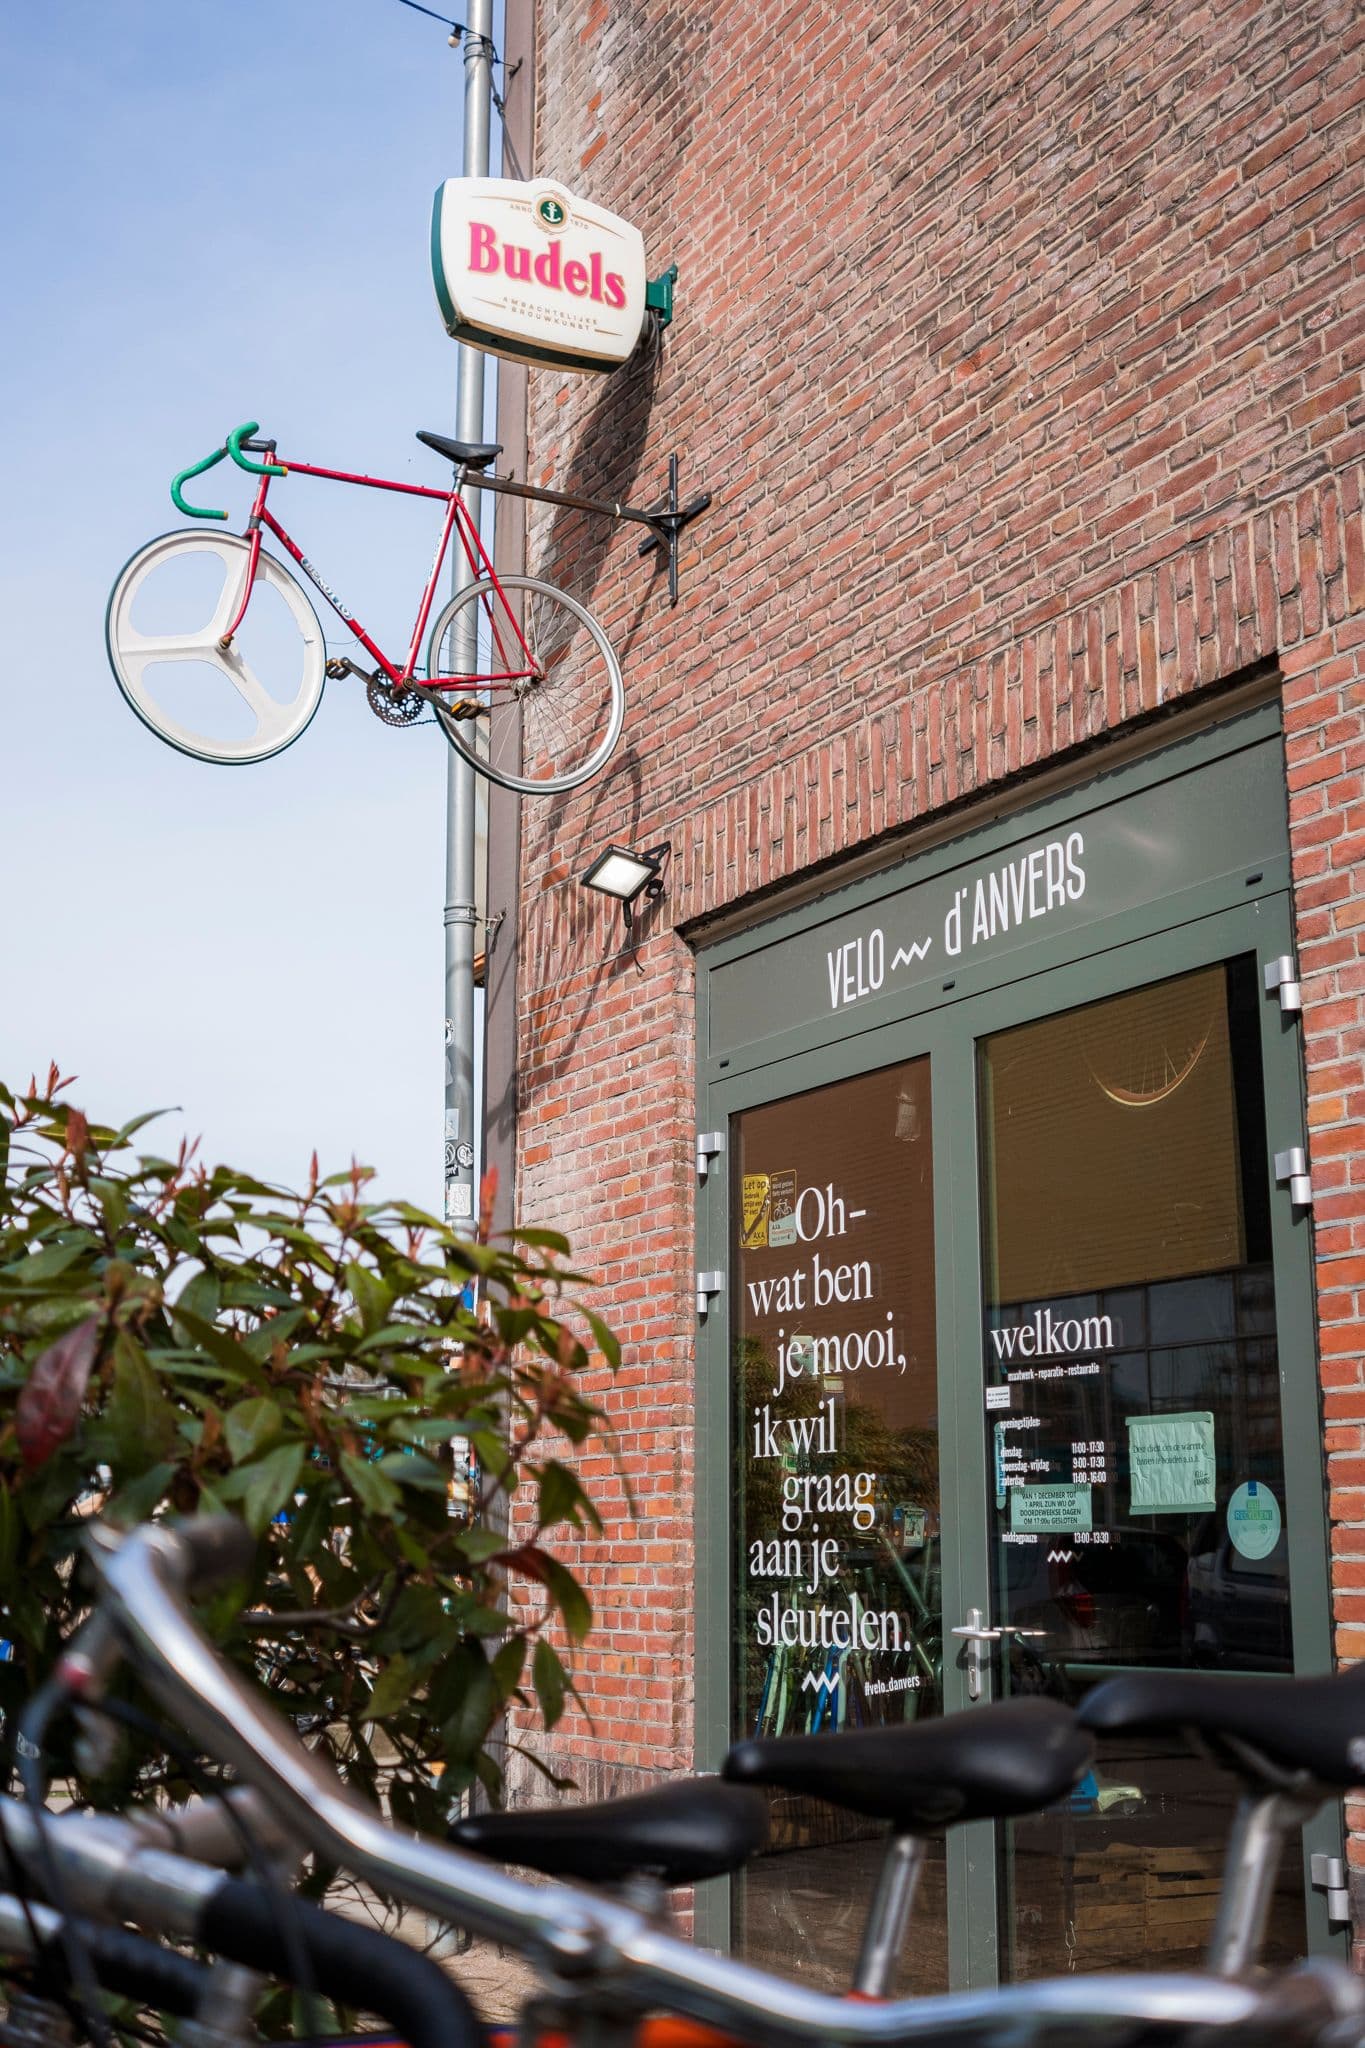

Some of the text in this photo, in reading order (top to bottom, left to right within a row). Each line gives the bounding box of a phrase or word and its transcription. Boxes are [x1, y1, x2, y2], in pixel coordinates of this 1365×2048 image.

[468, 222, 627, 309] Budels
[503, 296, 598, 325] AMBACHTELIJKE
[511, 307, 590, 331] BROUWKUNST
[827, 832, 1086, 1008] VELO d'ANVERS
[747, 1253, 874, 1316] wat ben
[990, 1308, 1115, 1359] welkom
[772, 1312, 906, 1397] je mooi,
[1038, 1365, 1064, 1380] reparatie
[1068, 1362, 1100, 1376] restauratie
[753, 1398, 838, 1458] ik wil
[1089, 1441, 1105, 1453] 17:30
[1030, 1459, 1050, 1472] vrijdag
[1090, 1456, 1105, 1468] 17:30
[781, 1472, 876, 1532] graag
[1021, 1492, 1033, 1500] VAN
[1038, 1491, 1065, 1499] DECEMBER
[1020, 1509, 1061, 1517] DOORDEWEEKSE
[1052, 1517, 1078, 1525] GESLOTEN
[1074, 1532, 1090, 1543] 13:00
[1093, 1532, 1109, 1543] 13:30
[750, 1523, 840, 1595] aan je
[757, 1591, 911, 1652] sleutelen.
[864, 1674, 920, 1697] #velo_danvers
